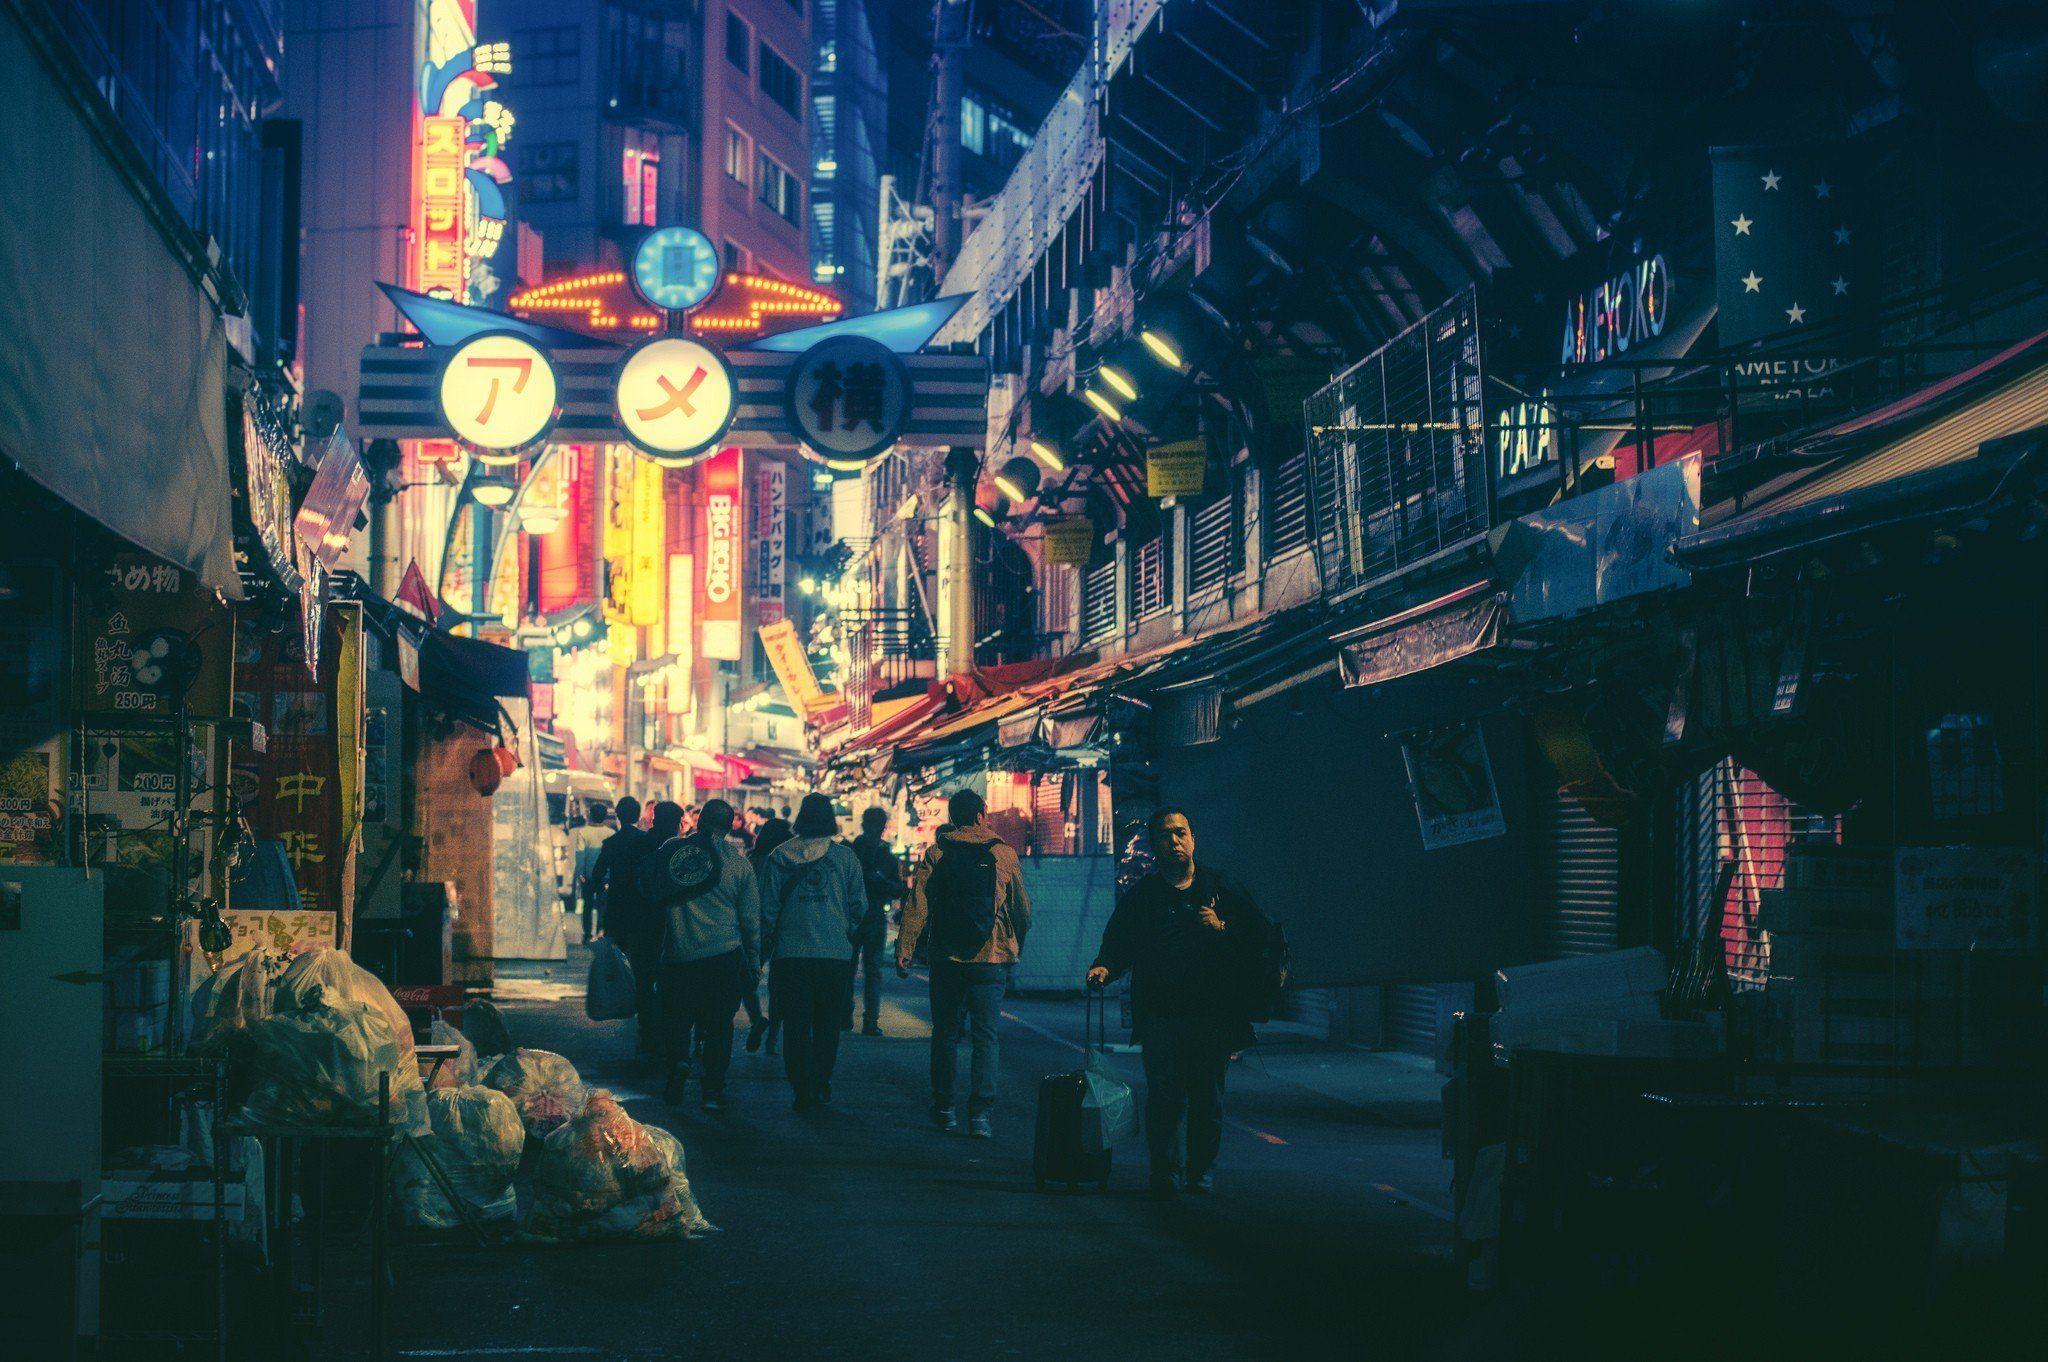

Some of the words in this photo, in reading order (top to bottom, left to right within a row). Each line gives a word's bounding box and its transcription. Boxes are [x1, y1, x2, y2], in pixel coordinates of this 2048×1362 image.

[1562, 253, 1668, 365] AMEYOKO
[1499, 387, 1557, 478] PLAZA
[708, 494, 731, 538] BIG
[706, 539, 731, 604] ECHO
[114, 692, 157, 709] 250円
